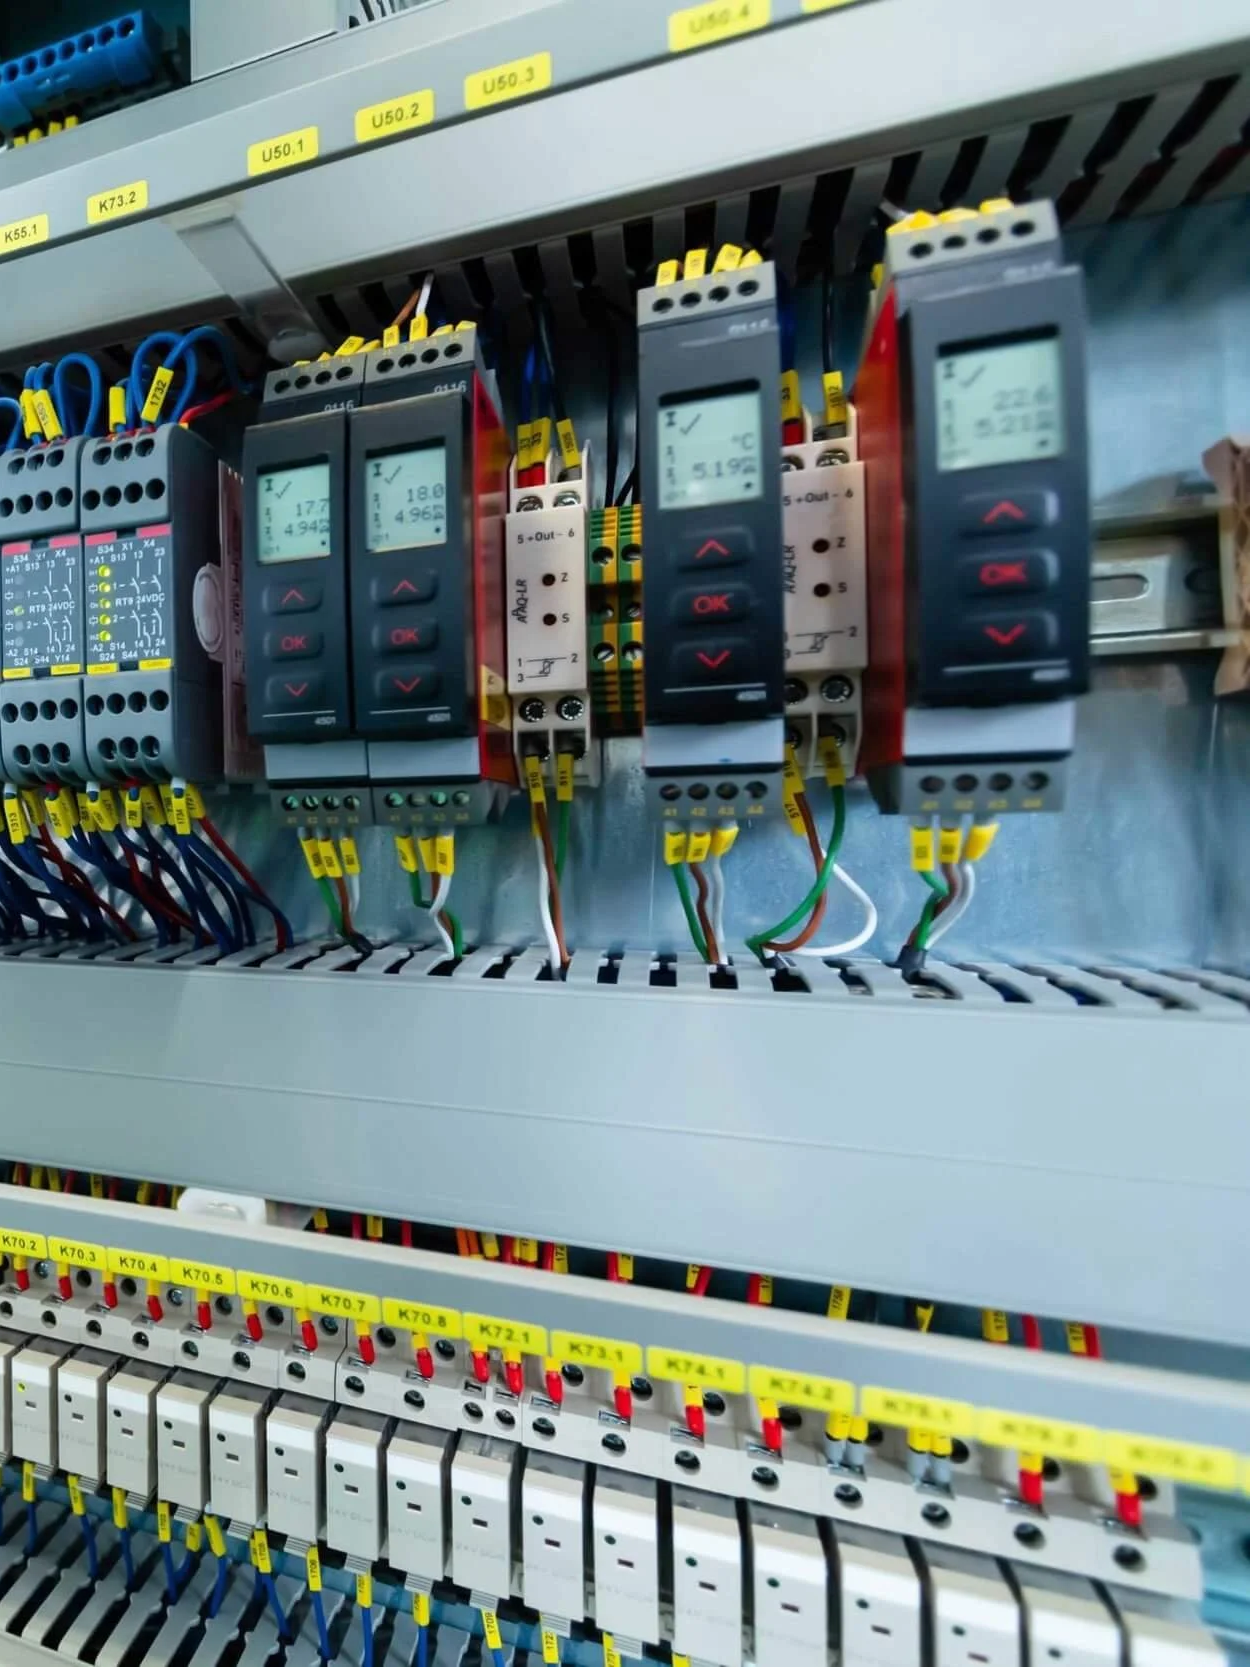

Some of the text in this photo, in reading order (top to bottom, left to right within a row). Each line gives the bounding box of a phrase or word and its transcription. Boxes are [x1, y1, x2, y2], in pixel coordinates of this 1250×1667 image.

[481, 66, 535, 96] U50.3
[371, 102, 420, 129] U50.2
[261, 139, 304, 163] U50.1
[98, 191, 137, 213] K73.2
[4, 225, 38, 245] K55.1
[149, 379, 167, 408] 1732
[406, 483, 445, 504] 18.0
[517, 534, 525, 545] 5
[568, 528, 575, 538] 6
[98, 539, 156, 554] S34 X1 X4
[110, 553, 126, 562] S13
[134, 551, 144, 559] 13
[154, 548, 165, 557] 23
[13, 550, 67, 564] S34 X4
[25, 562, 40, 572] S13
[46, 560, 56, 568] 13
[65, 558, 76, 566] 23
[979, 561, 1027, 586] OK
[693, 595, 730, 613] OK
[110, 642, 126, 650] S14
[134, 640, 144, 648] 14
[155, 638, 166, 646] 24
[281, 635, 307, 651] OK
[391, 627, 419, 645] OK
[66, 644, 76, 652] 24
[100, 652, 115, 661] S24
[122, 651, 138, 659] S44
[14, 658, 29, 666] S24
[54, 654, 70, 662] Y14
[1, 1234, 38, 1251] K70.2
[59, 1245, 96, 1262] K70.3
[118, 1255, 158, 1273] K70.4
[182, 1266, 224, 1286] K70.5
[249, 1279, 294, 1299] K70.6
[320, 1293, 366, 1313] K70.7
[398, 1307, 447, 1329] K70.8
[478, 1323, 530, 1345] K72.1
[568, 1340, 625, 1363] K73.1
[665, 1356, 726, 1381] K74.1
